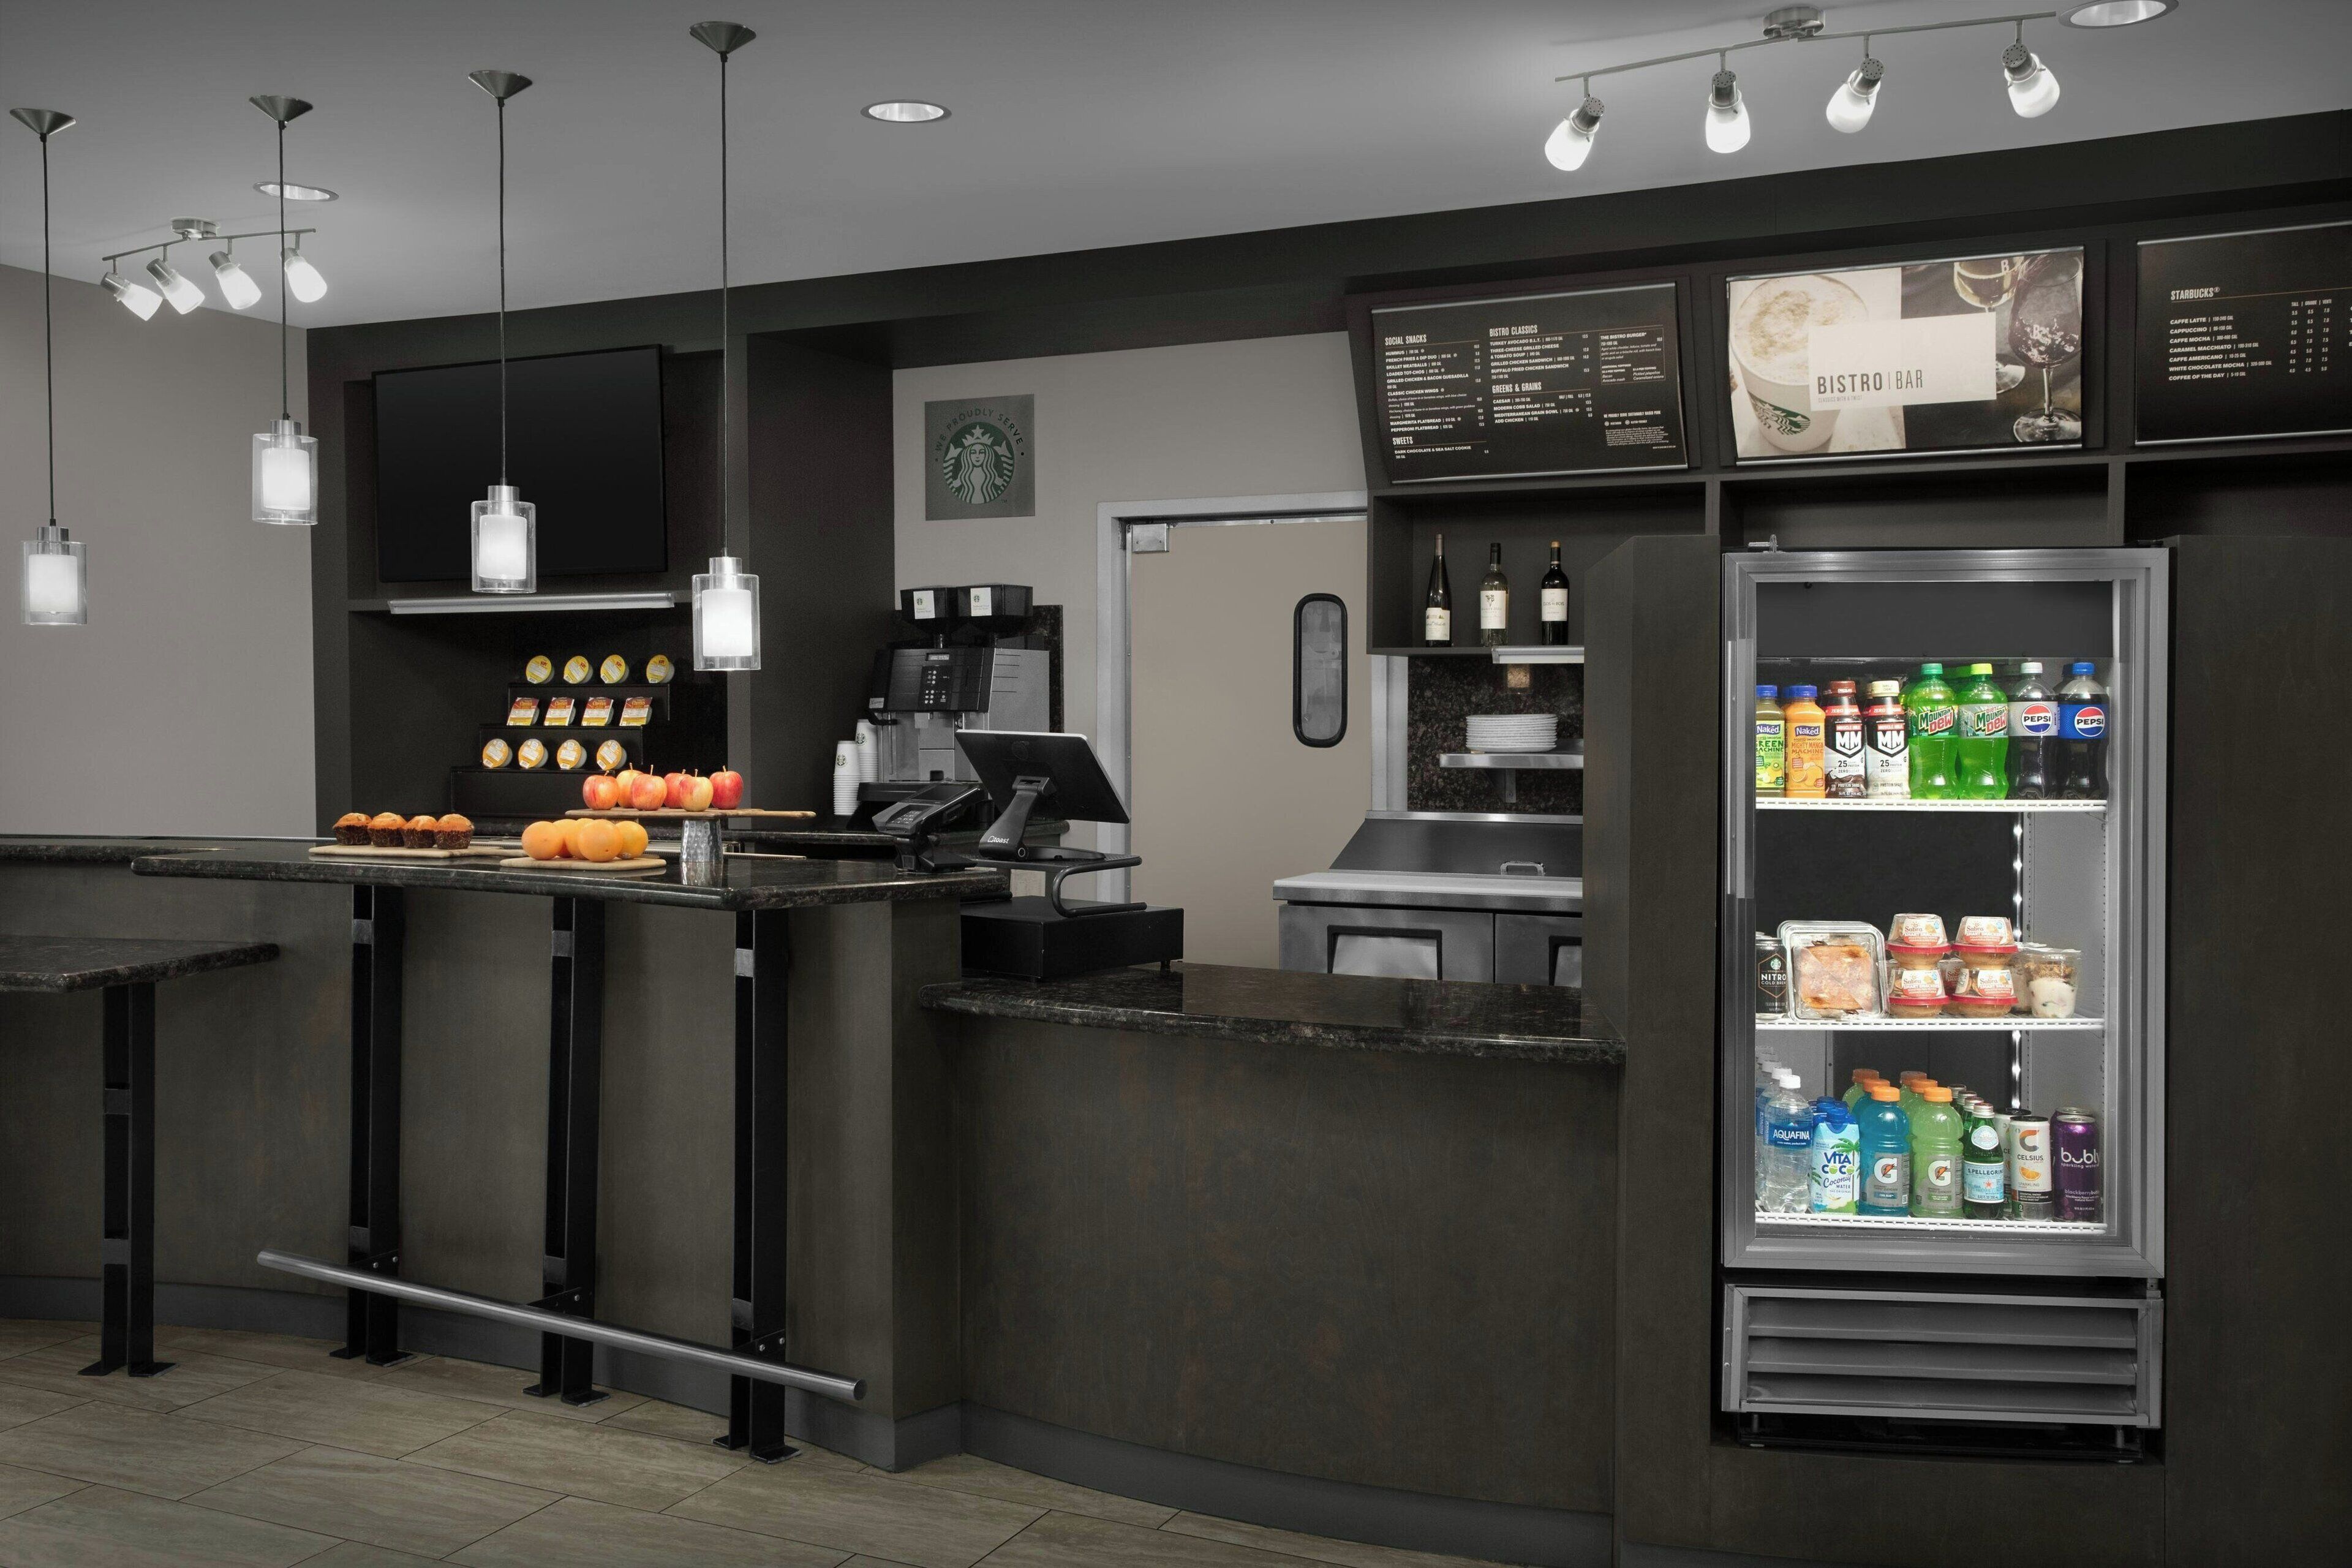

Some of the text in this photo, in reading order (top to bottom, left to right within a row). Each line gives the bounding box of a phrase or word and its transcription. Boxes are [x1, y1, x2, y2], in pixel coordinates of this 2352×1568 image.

[1490, 325, 1537, 337] BISTRO CLASSICS
[1385, 334, 1427, 345] SOCIAL SNACKS
[1492, 384, 1512, 393] GREENS
[1521, 382, 1542, 391] GRAINS
[1818, 369, 1923, 394] BISTRO BAR
[935, 408, 1023, 451] WE PROUDLY SERVE
[1393, 437, 1413, 445] SWEETS
[1773, 1129, 1810, 1140] AQUAFINA
[1824, 1152, 1852, 1164] VITA
[1822, 1164, 1855, 1174] COCO
[1874, 1158, 1898, 1183] G
[1928, 1160, 1951, 1186] G
[1823, 1174, 1852, 1188] Coconut
